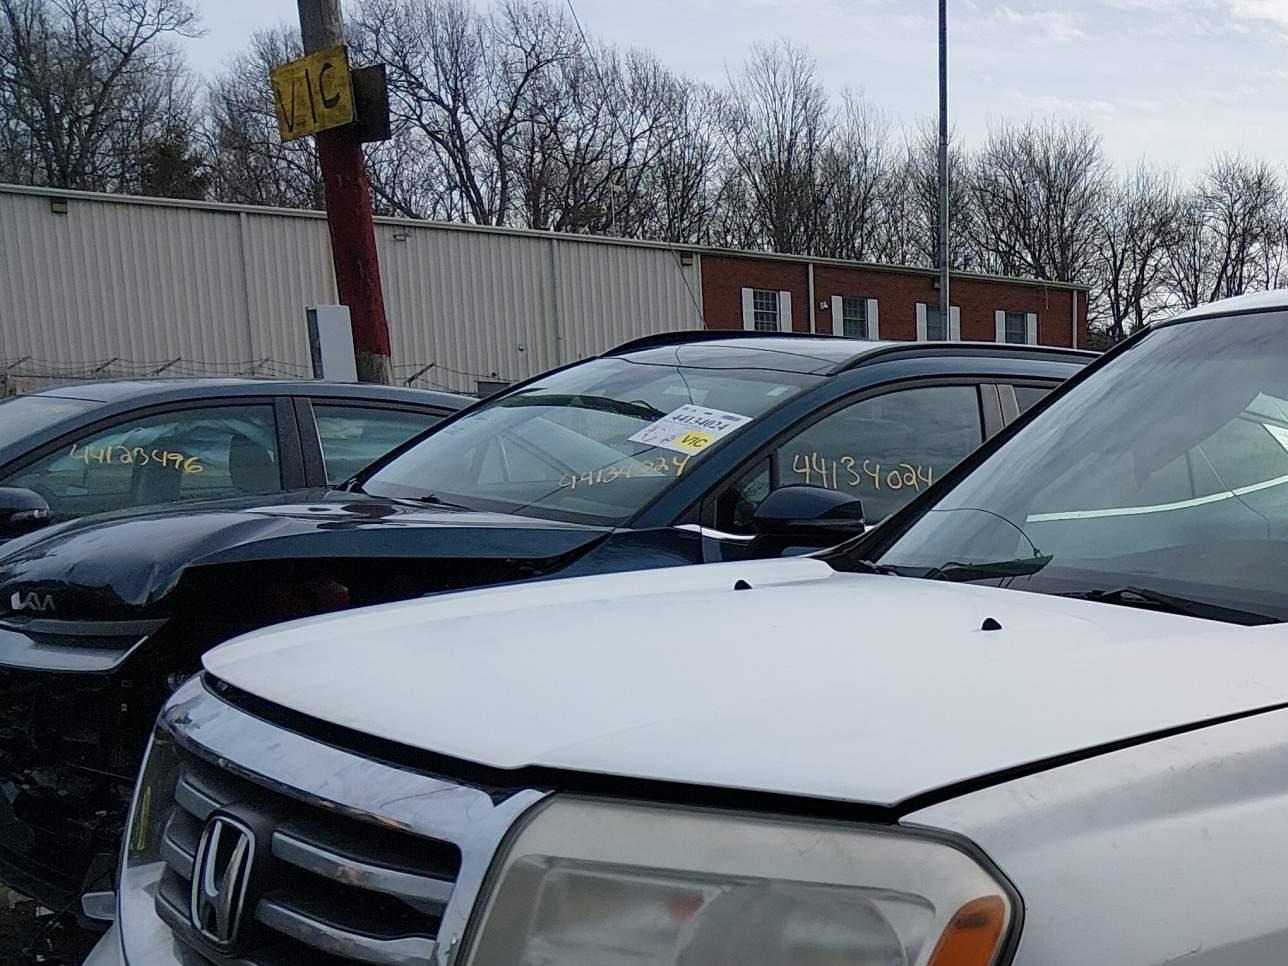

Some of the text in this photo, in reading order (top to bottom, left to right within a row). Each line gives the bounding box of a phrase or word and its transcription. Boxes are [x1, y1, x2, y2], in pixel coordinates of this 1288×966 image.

[277, 63, 340, 133] VIC
[70, 443, 204, 473] 44123496
[681, 433, 708, 448] VIC
[793, 452, 933, 492] 44134024
